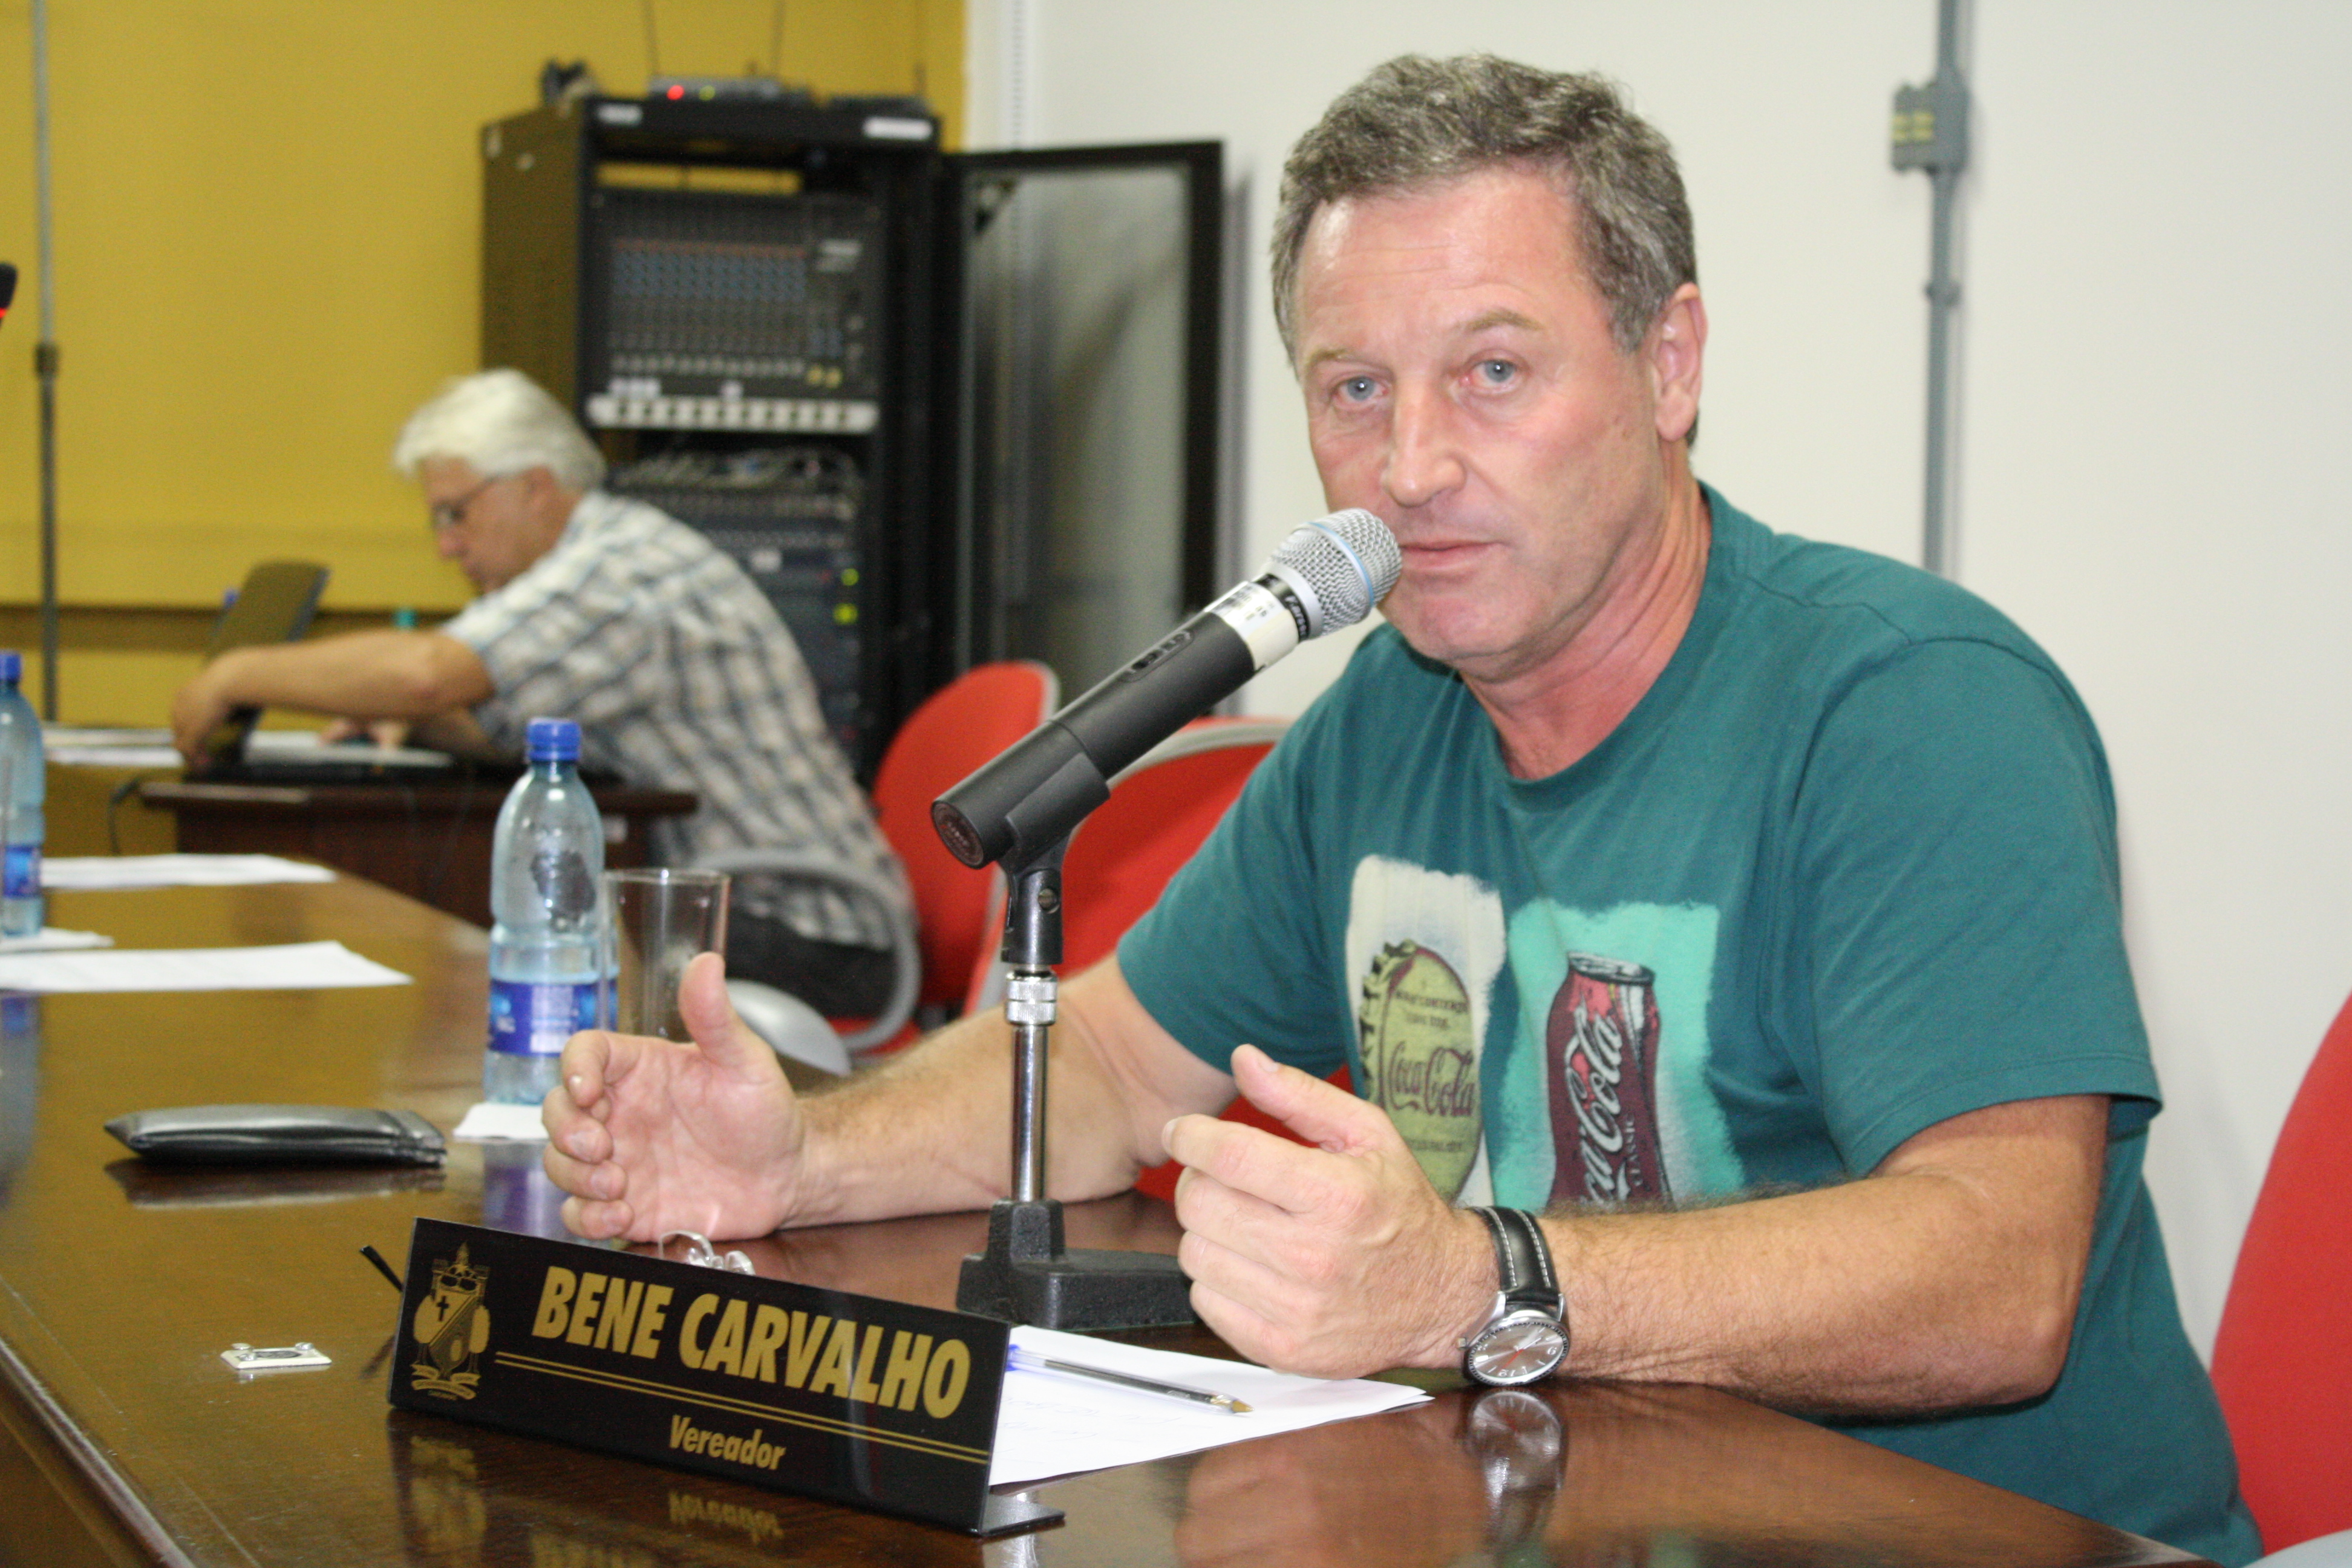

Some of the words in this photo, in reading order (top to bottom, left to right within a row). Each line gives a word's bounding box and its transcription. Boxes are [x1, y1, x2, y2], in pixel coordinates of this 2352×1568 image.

[532, 1266, 674, 1359] BENE
[679, 1293, 970, 1419] CARVALHO
[670, 1414, 786, 1471] Vereador
